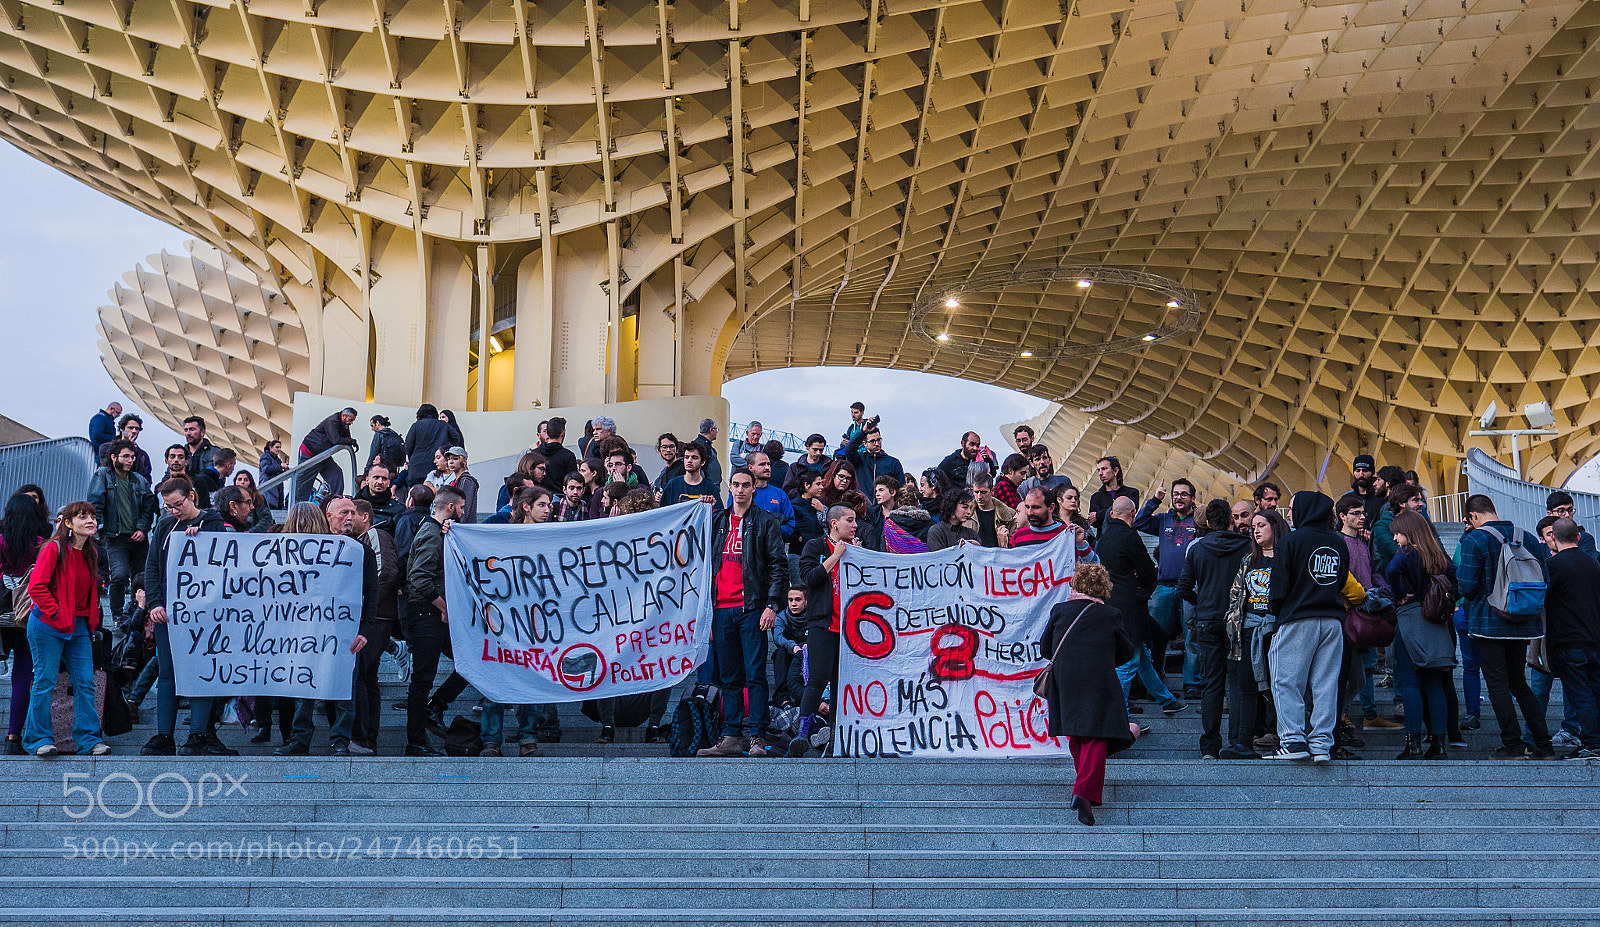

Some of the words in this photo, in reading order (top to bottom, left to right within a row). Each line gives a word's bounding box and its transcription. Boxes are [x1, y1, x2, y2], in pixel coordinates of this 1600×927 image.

[178, 539, 198, 567] A
[207, 537, 239, 568] LA
[252, 536, 352, 568] CÁRCEL
[176, 571, 215, 600] Por
[222, 568, 320, 600] Luchar
[984, 559, 1073, 596] ILEGAL
[172, 601, 206, 625] Por
[213, 606, 256, 623] una
[262, 597, 355, 623] vivienda
[471, 598, 504, 636] NO
[510, 599, 564, 645] NOS
[571, 567, 700, 634] CALLARÁ
[203, 624, 232, 656] le
[242, 620, 338, 656] llaman
[842, 590, 896, 660] 6
[928, 624, 980, 682] 8
[199, 657, 317, 689] Justicia
[843, 681, 888, 717] NO
[897, 672, 948, 716] MÁS
